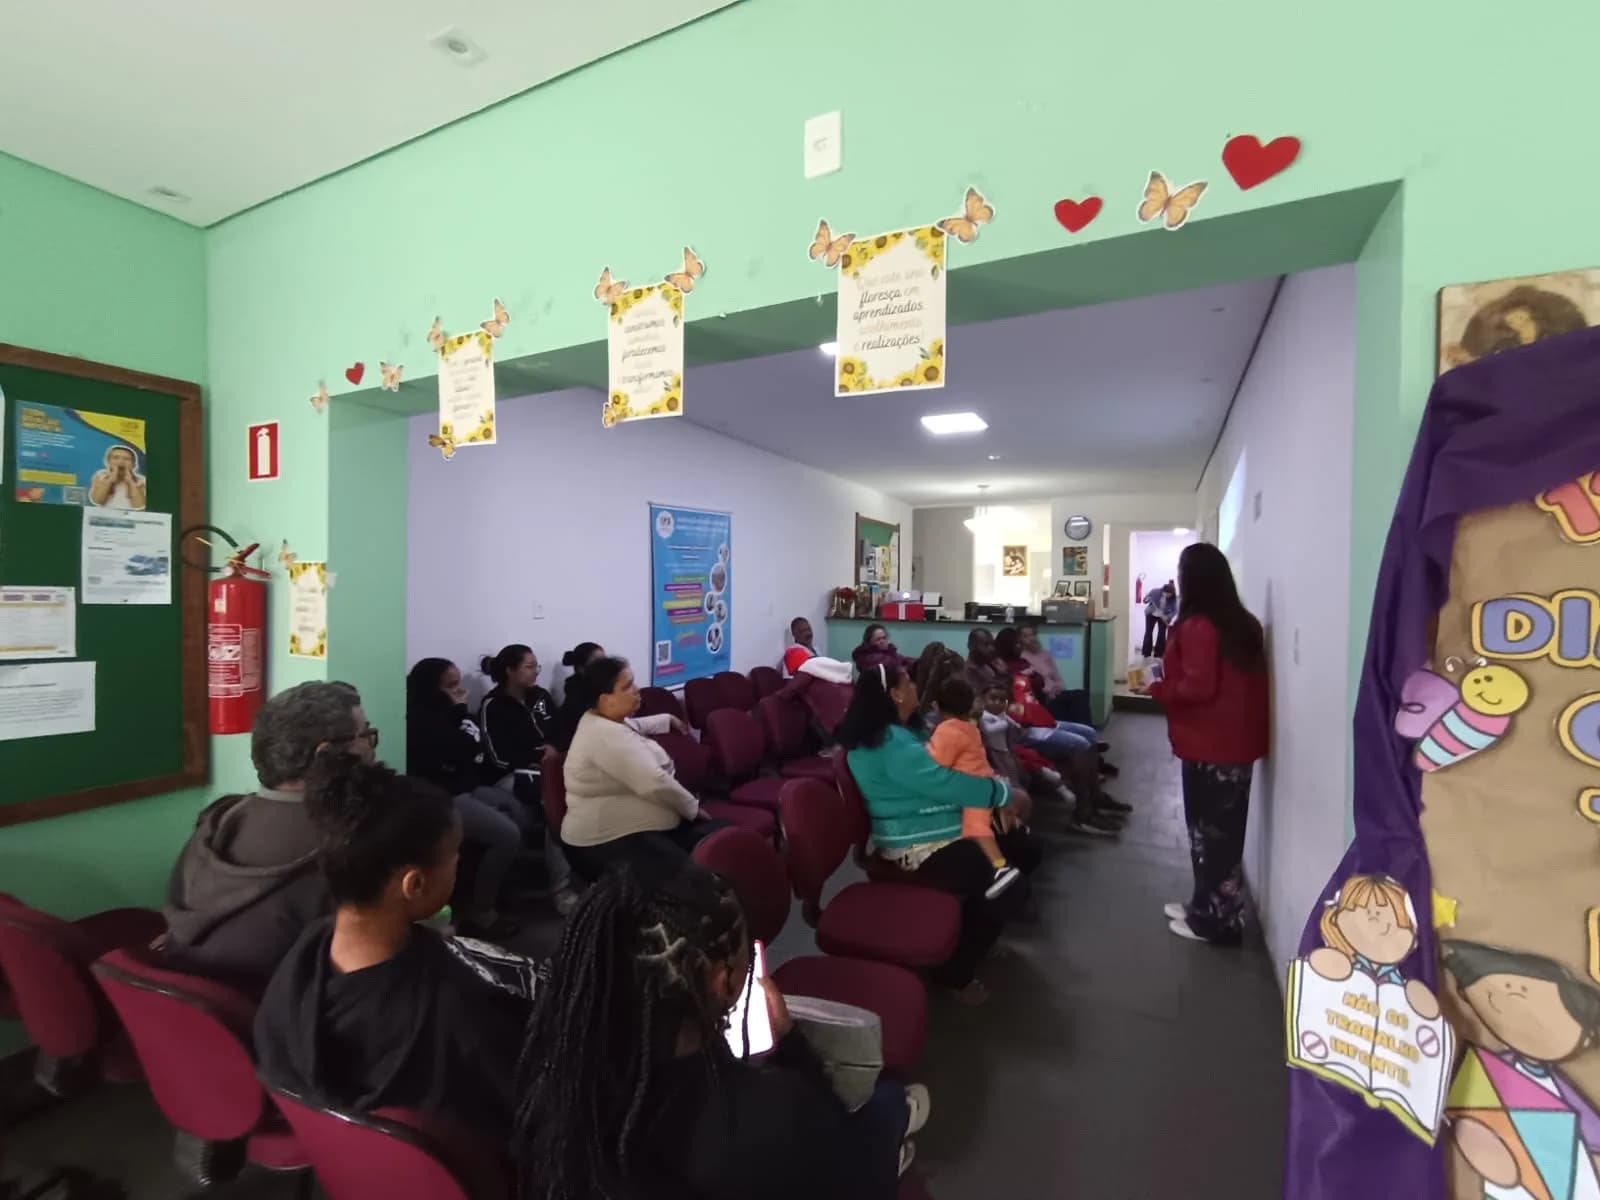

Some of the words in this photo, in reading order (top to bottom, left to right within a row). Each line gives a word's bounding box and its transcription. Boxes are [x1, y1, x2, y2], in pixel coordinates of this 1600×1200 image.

[858, 288, 902, 309] floresça
[852, 300, 924, 324] aprendizados
[1471, 590, 1600, 668] DI
[1342, 991, 1380, 1018] NÃO
